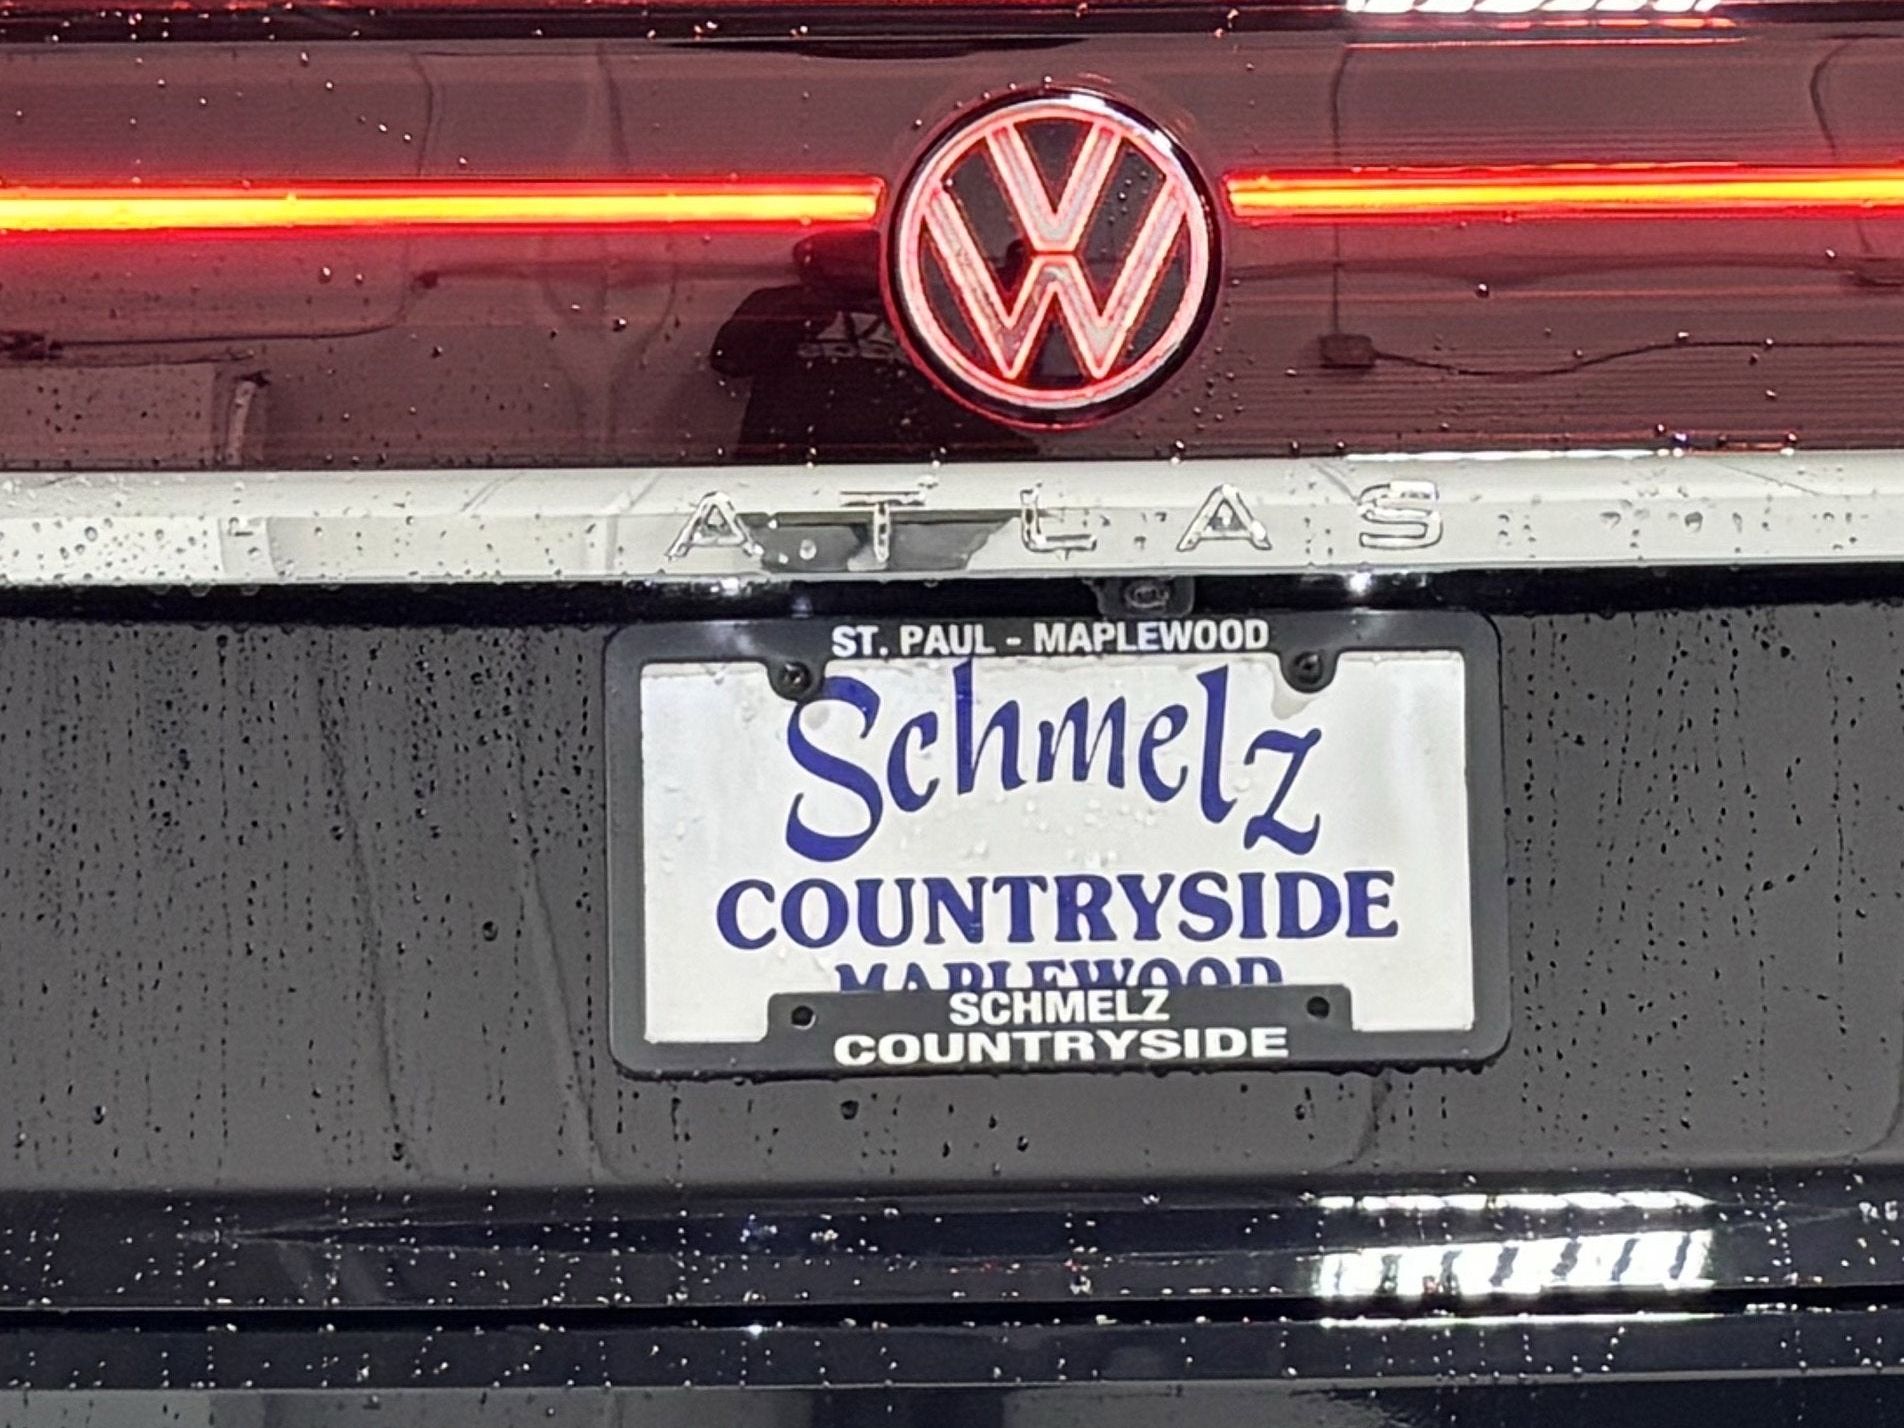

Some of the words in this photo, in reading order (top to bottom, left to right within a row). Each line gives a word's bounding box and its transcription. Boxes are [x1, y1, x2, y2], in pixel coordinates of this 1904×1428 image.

[666, 481, 1445, 562] ATLAS
[831, 627, 892, 659] ST.
[900, 625, 995, 657] PAUL
[1033, 619, 1270, 654] MAPLEWOOD
[785, 657, 1322, 863] Schmelz
[716, 870, 1399, 950] COUNTRYSIDE
[949, 989, 1170, 1026] SCHMELZ
[833, 1027, 1289, 1067] COUNTRYSIDE
